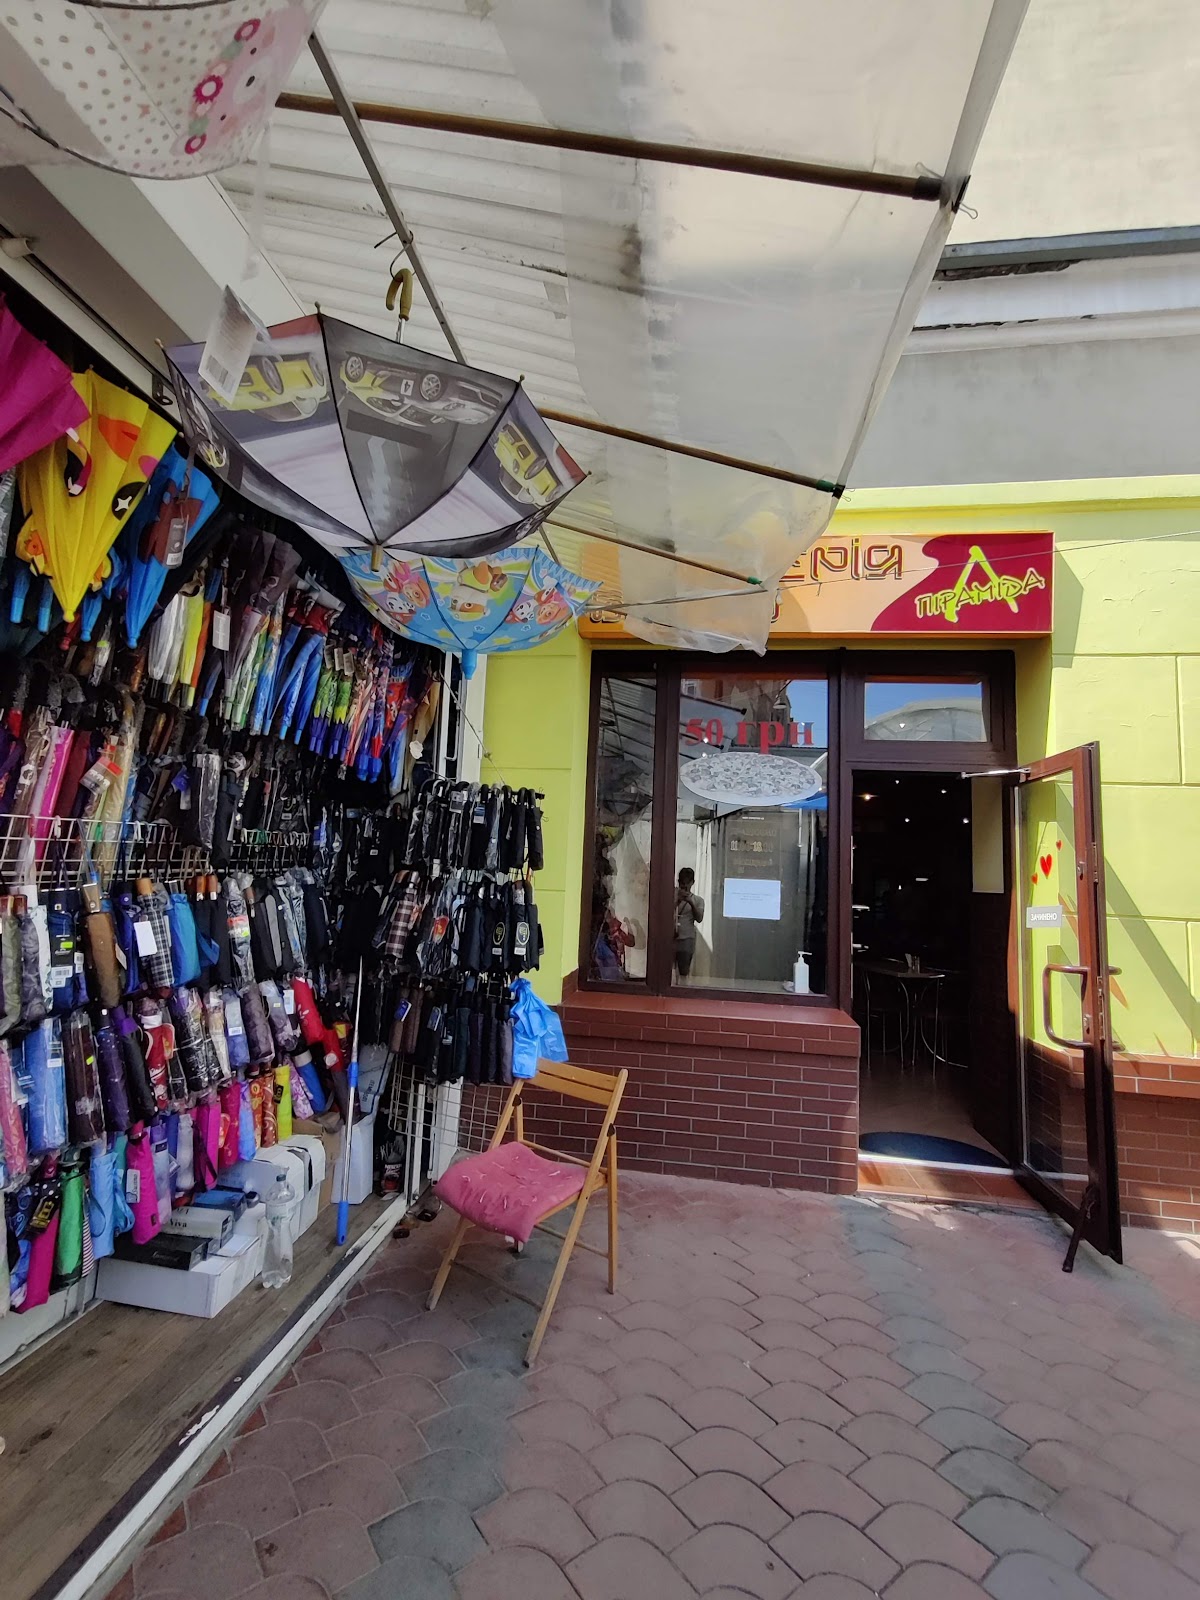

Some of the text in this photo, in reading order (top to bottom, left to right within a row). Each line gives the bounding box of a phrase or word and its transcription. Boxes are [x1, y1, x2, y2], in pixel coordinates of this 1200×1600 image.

[685, 718, 815, 754] 50 грн
[1030, 912, 1058, 921] ЗАЧИНЕНО
